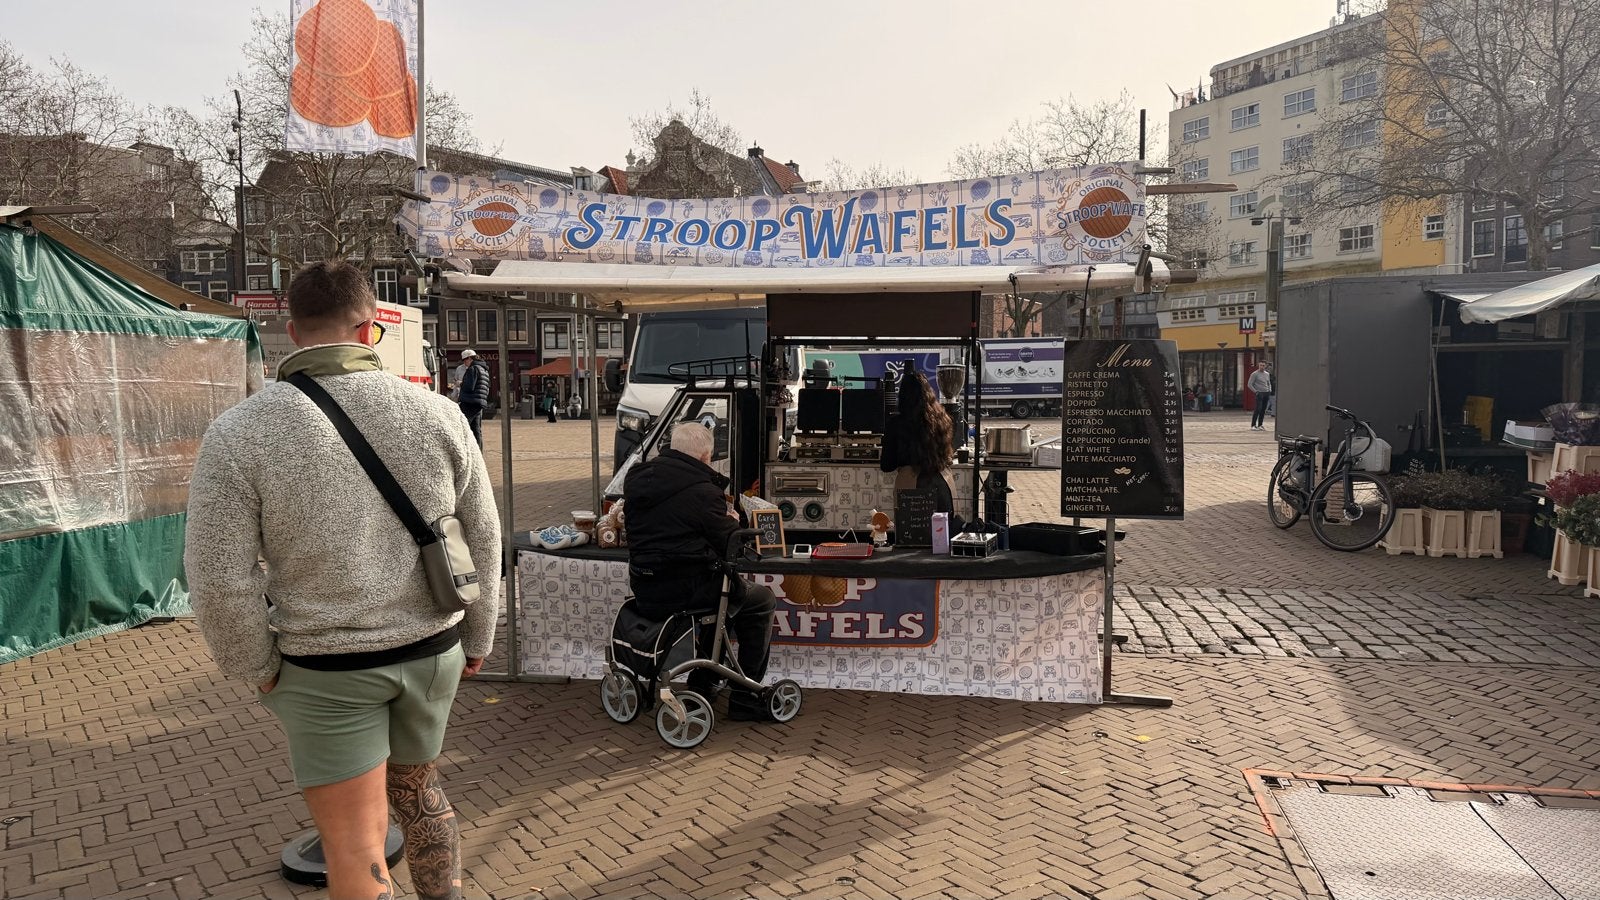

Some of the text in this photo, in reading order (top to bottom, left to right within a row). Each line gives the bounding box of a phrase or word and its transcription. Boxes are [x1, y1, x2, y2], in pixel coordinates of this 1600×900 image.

[1079, 179, 1124, 197] ORIGINAL
[477, 194, 518, 207] ORIGINAL
[563, 196, 1016, 259] STROOP WAFELS
[470, 229, 515, 247] SOCIETY
[1080, 227, 1134, 249] SOCIETY
[381, 311, 401, 321] Service
[1242, 318, 1254, 329] M
[1096, 343, 1153, 368] Menu
[1093, 371, 1120, 379] CREMA
[1067, 390, 1105, 398] ESPRESSO
[1067, 399, 1097, 407] DOPPIO
[1066, 418, 1104, 426] CORTADO
[1066, 427, 1116, 435] CAPPUCCINO
[1066, 436, 1151, 445] CAPPUCCINO (Grande)
[1066, 455, 1137, 463] LATTE MACCHIATO
[1065, 476, 1084, 484] CHAI
[1088, 495, 1102, 503] TEA
[1065, 504, 1111, 512] GINGER TEA
[771, 610, 925, 639] AFELS
